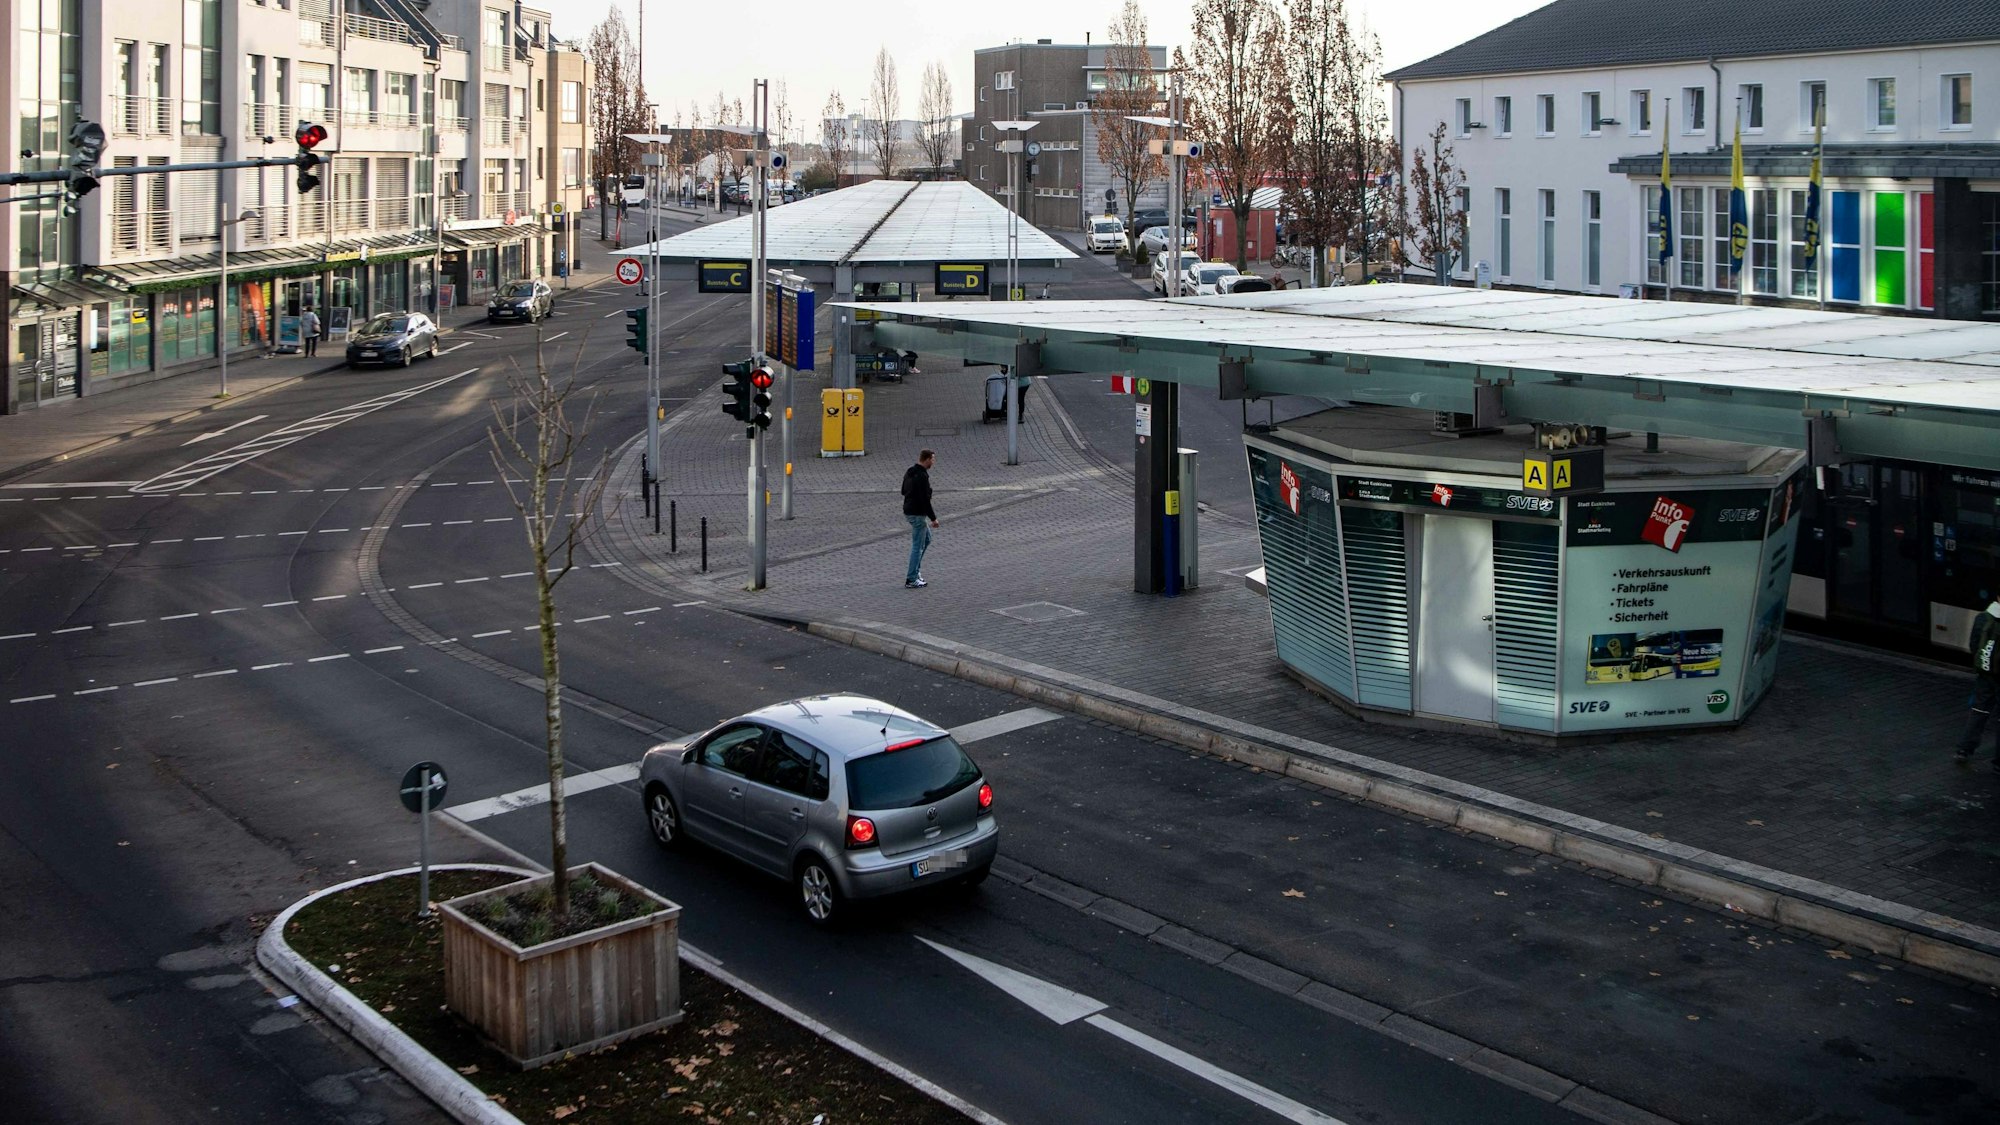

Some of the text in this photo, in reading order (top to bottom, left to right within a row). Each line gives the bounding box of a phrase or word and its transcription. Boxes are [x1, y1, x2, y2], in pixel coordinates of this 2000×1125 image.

[730, 272, 741, 286] C
[966, 274, 979, 288] D
[1528, 465, 1543, 485] A
[1555, 465, 1568, 484] A
[1506, 495, 1538, 511] SVE
[1653, 497, 1683, 520] info
[1650, 512, 1673, 525] Punkt
[1718, 508, 1747, 522] SVE
[1618, 565, 1711, 579] Verkehrsauskunft
[1617, 582, 1669, 594] Fahrpläne
[1616, 598, 1655, 608] Tickets
[1614, 611, 1669, 623] Sicherheit
[1980, 640, 1995, 672] adidas
[1707, 694, 1725, 704] VRS
[1569, 701, 1598, 714] SVE
[1643, 709, 1666, 717] Partner
[918, 860, 929, 874] SU
